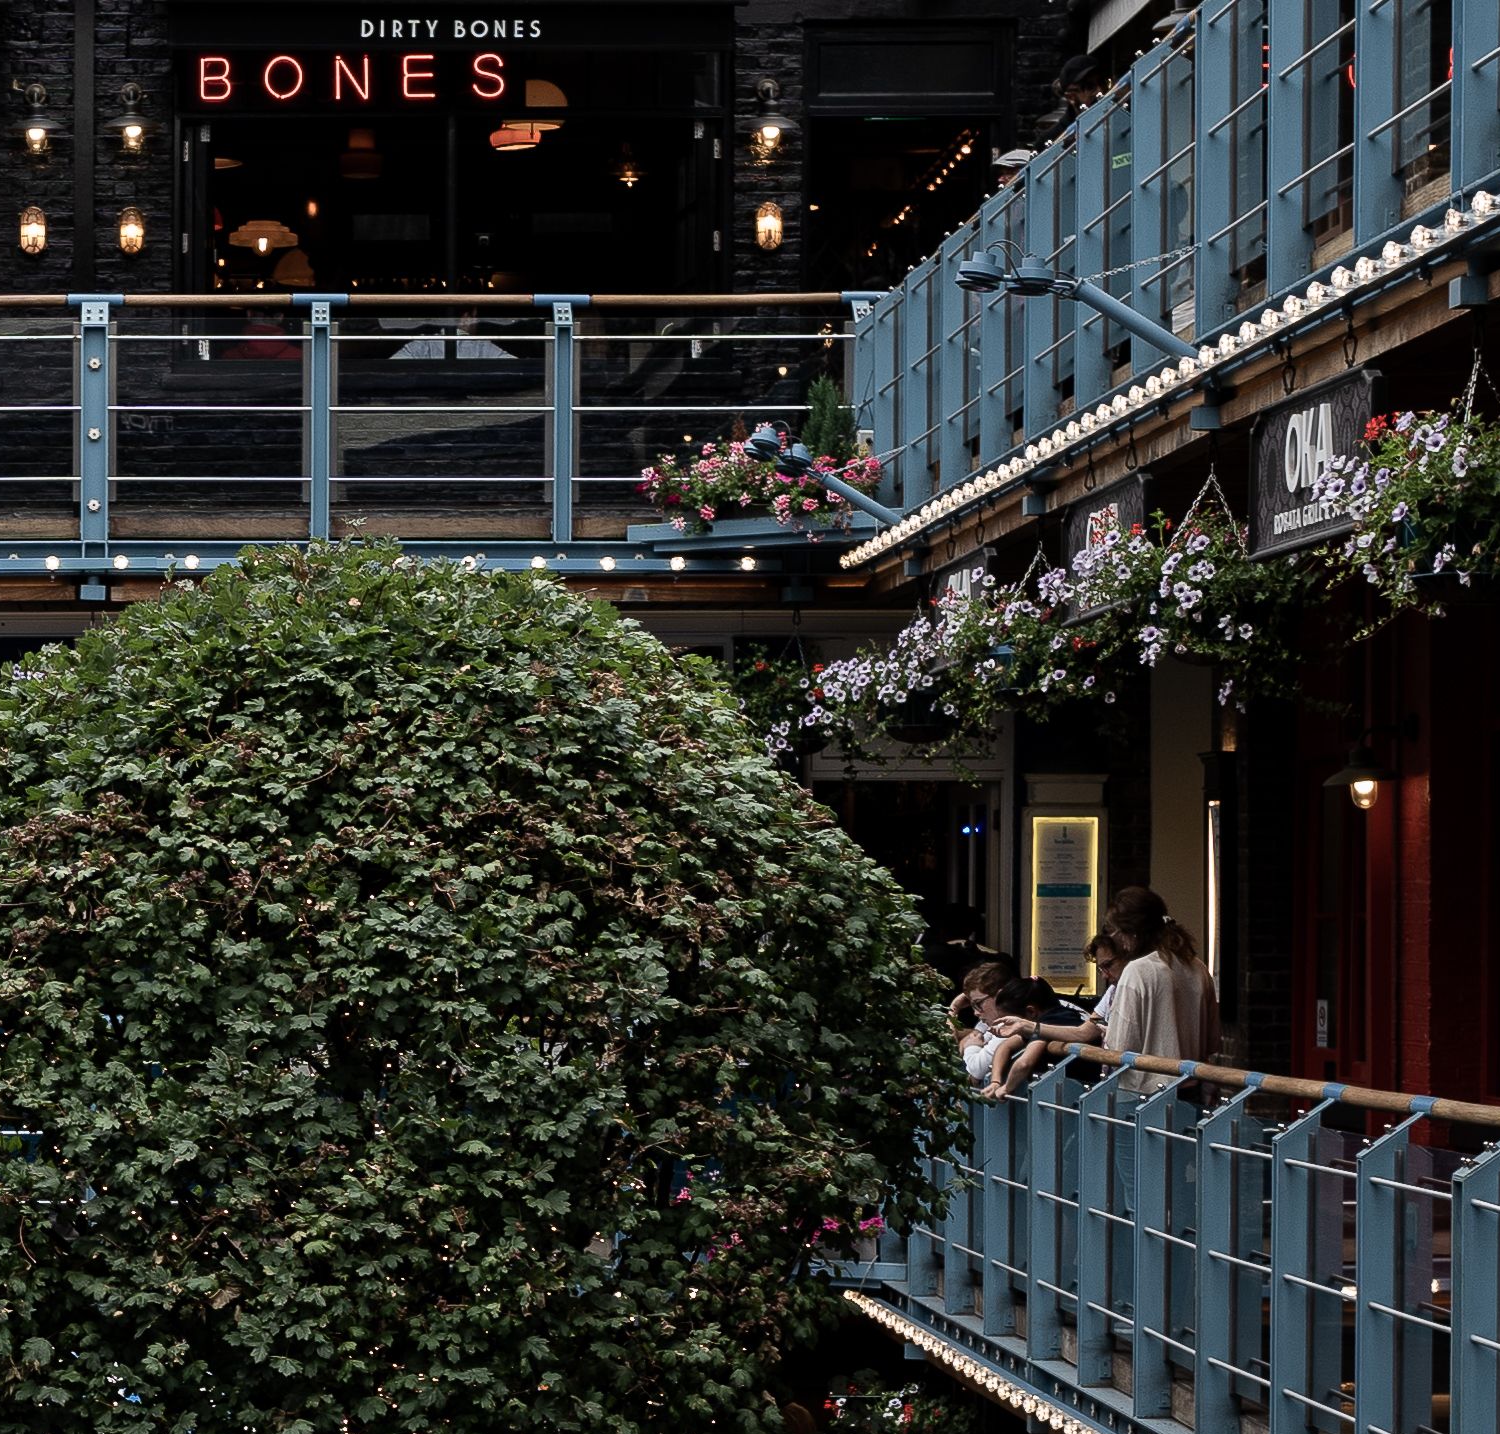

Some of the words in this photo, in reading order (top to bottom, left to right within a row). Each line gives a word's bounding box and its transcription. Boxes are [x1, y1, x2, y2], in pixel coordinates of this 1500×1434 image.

[360, 19, 439, 39] DIRTY
[454, 19, 542, 39] BONES
[199, 53, 507, 101] BONES
[1285, 403, 1334, 493] OKA
